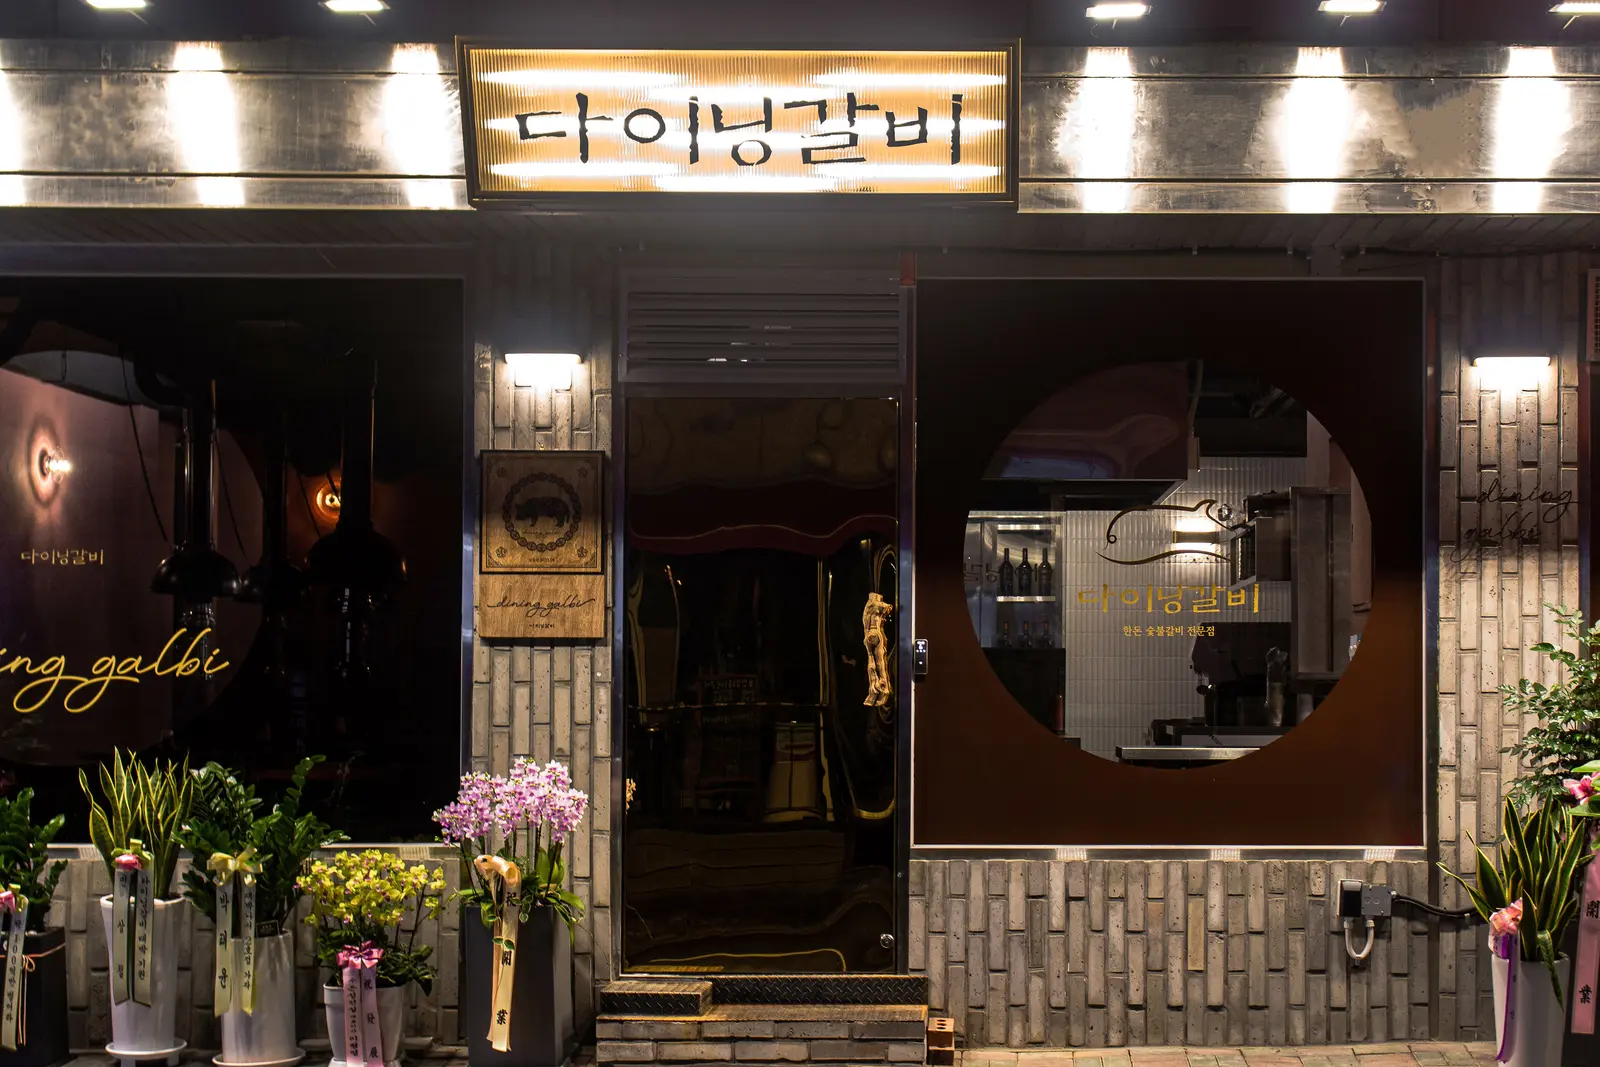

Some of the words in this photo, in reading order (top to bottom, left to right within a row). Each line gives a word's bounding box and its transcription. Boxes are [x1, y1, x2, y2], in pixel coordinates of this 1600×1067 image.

[515, 92, 963, 166] 다이닝갈비
[1476, 478, 1582, 523] dining
[21, 548, 104, 565] 다이닝갈비
[487, 595, 546, 617] dining
[540, 595, 596, 617] galbi
[1077, 583, 1260, 614] 다이닝갈비
[1122, 625, 1142, 636] 한돈
[1145, 625, 1184, 637] 숯불갈비
[1187, 625, 1216, 637] 전문점
[64, 628, 230, 713] galbi
